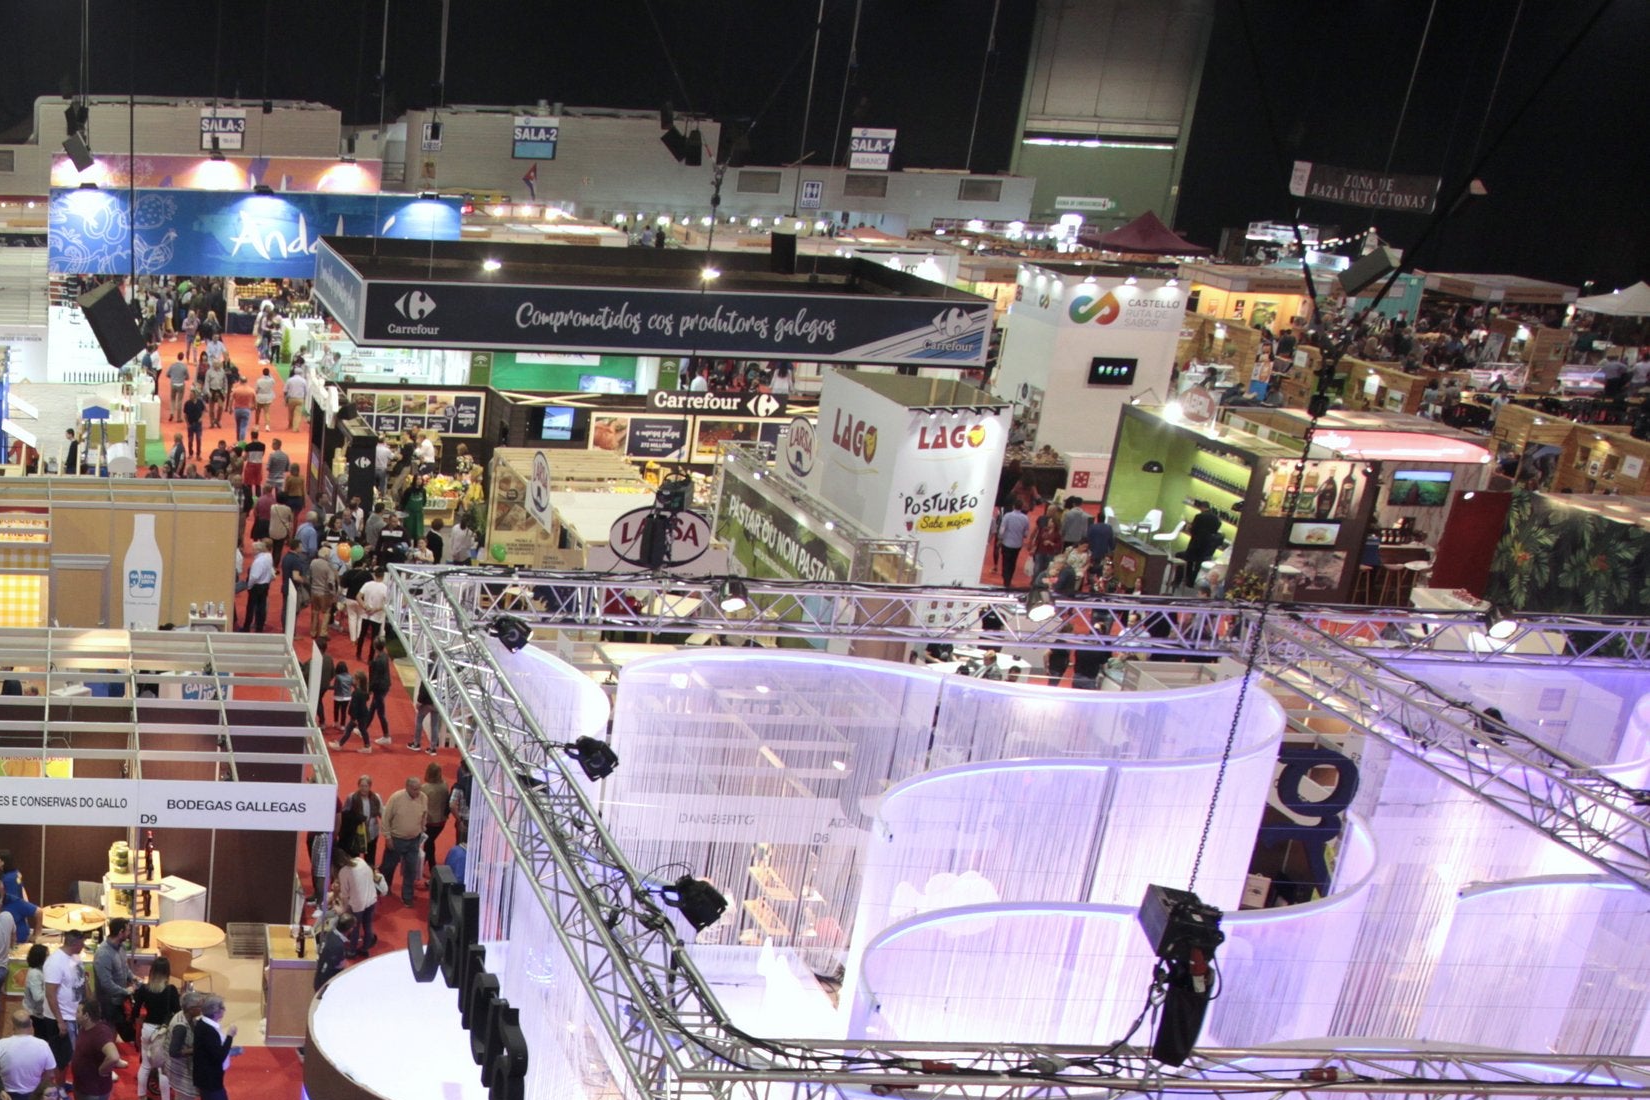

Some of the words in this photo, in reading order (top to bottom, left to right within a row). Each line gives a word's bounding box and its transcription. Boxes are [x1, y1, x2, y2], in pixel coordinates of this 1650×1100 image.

[201, 118, 246, 132] SALA-3
[514, 128, 558, 141] SALA-2
[851, 138, 895, 153] SALA-1
[1344, 174, 1373, 189] ZONA
[1379, 178, 1395, 192] DE
[1311, 182, 1345, 200] RAZAS
[515, 302, 641, 335] Comprometidos
[648, 311, 673, 336] cos
[679, 304, 770, 339] produtores
[774, 308, 837, 343] galegos
[1124, 318, 1159, 328] SABOR
[1154, 311, 1168, 320] DE
[387, 323, 440, 335] Carrefour
[923, 339, 974, 352] Carrefour
[654, 391, 741, 410] Carrefour
[832, 407, 878, 465] LAGO
[918, 424, 987, 450] LAGO
[788, 427, 813, 461] LARSA
[919, 515, 944, 529] Sabe
[620, 514, 700, 548] LASA
[728, 495, 760, 540] PASTAR
[761, 520, 777, 550] OU
[776, 531, 799, 571] NON
[12, 796, 18, 807] E
[20, 796, 78, 809] CONSERVAS
[79, 798, 94, 809] DO
[95, 798, 128, 810] GALLO
[166, 799, 233, 812] BODEGAS
[235, 800, 307, 814] GALLEGAS
[140, 813, 158, 825] D9
